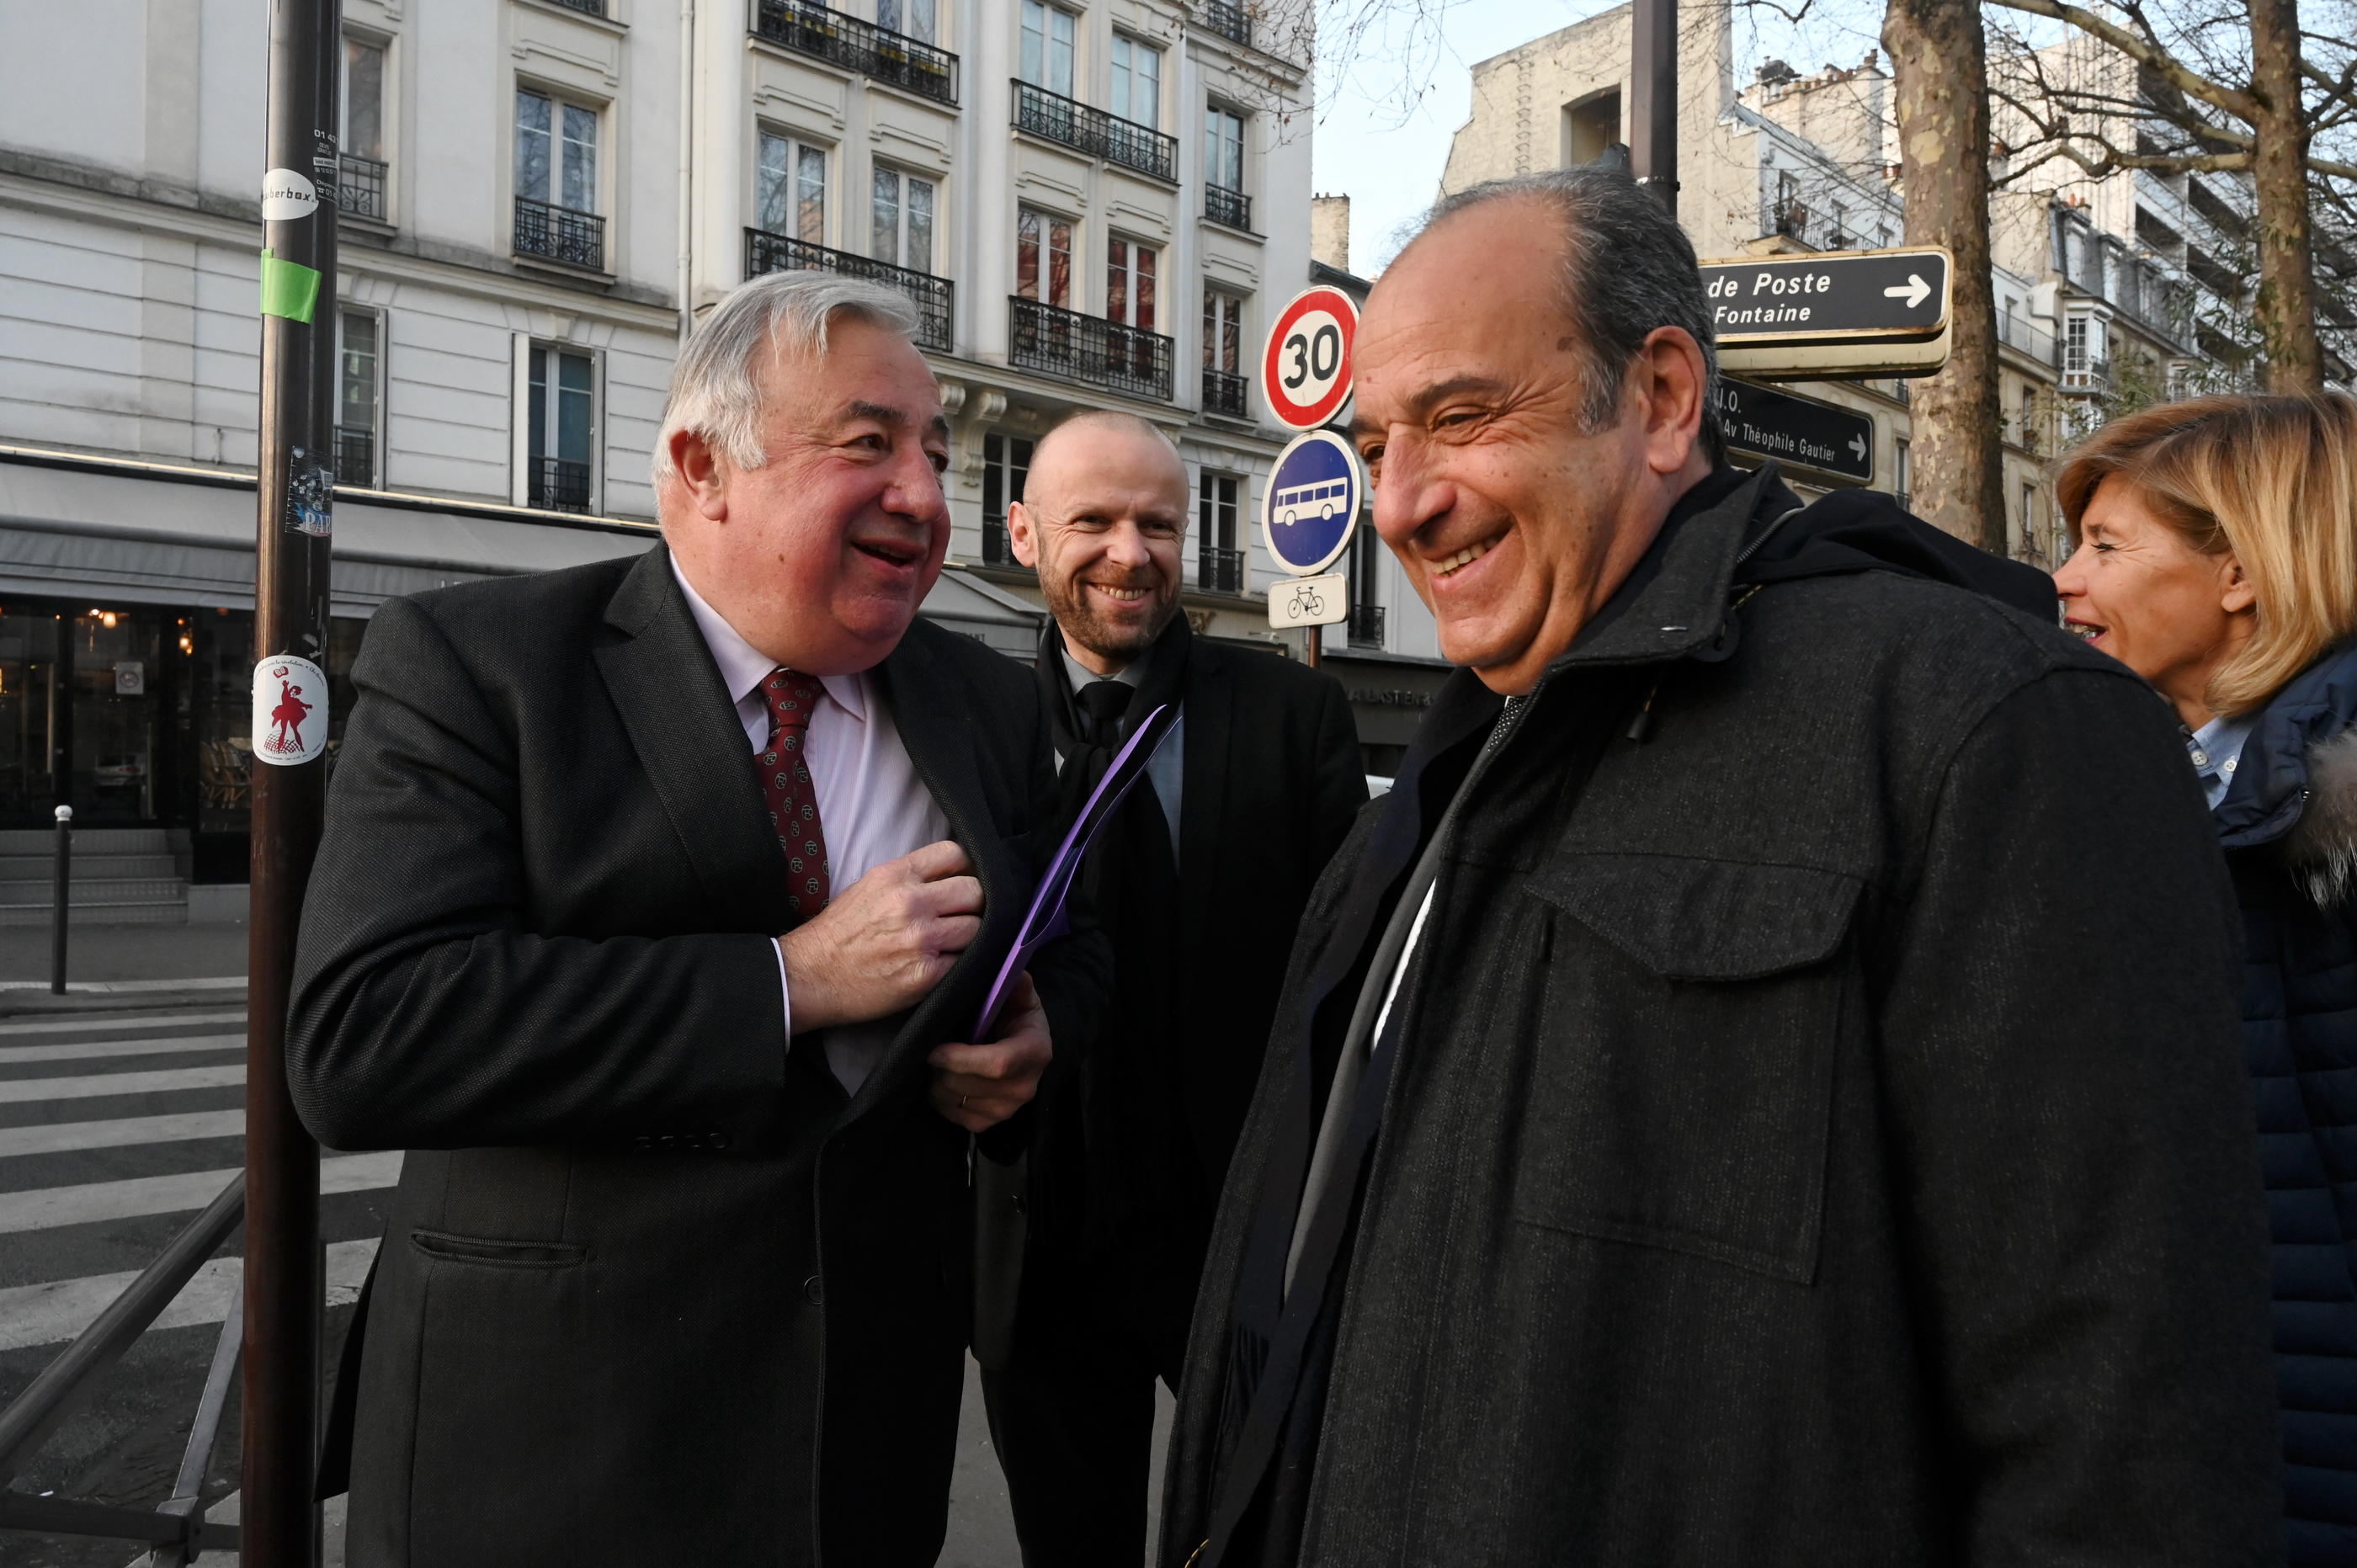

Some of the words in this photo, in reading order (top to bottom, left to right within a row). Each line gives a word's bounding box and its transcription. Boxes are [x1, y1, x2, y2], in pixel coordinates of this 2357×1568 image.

[314, 129, 325, 139] 01
[1708, 275, 1738, 298] de
[1752, 273, 1831, 296] Poste
[1714, 303, 1811, 324] Fontaine
[1284, 324, 1339, 389] 30
[1724, 418, 1737, 438] Av
[1742, 423, 1795, 452] Théophile
[1799, 438, 1836, 462] Gautier
